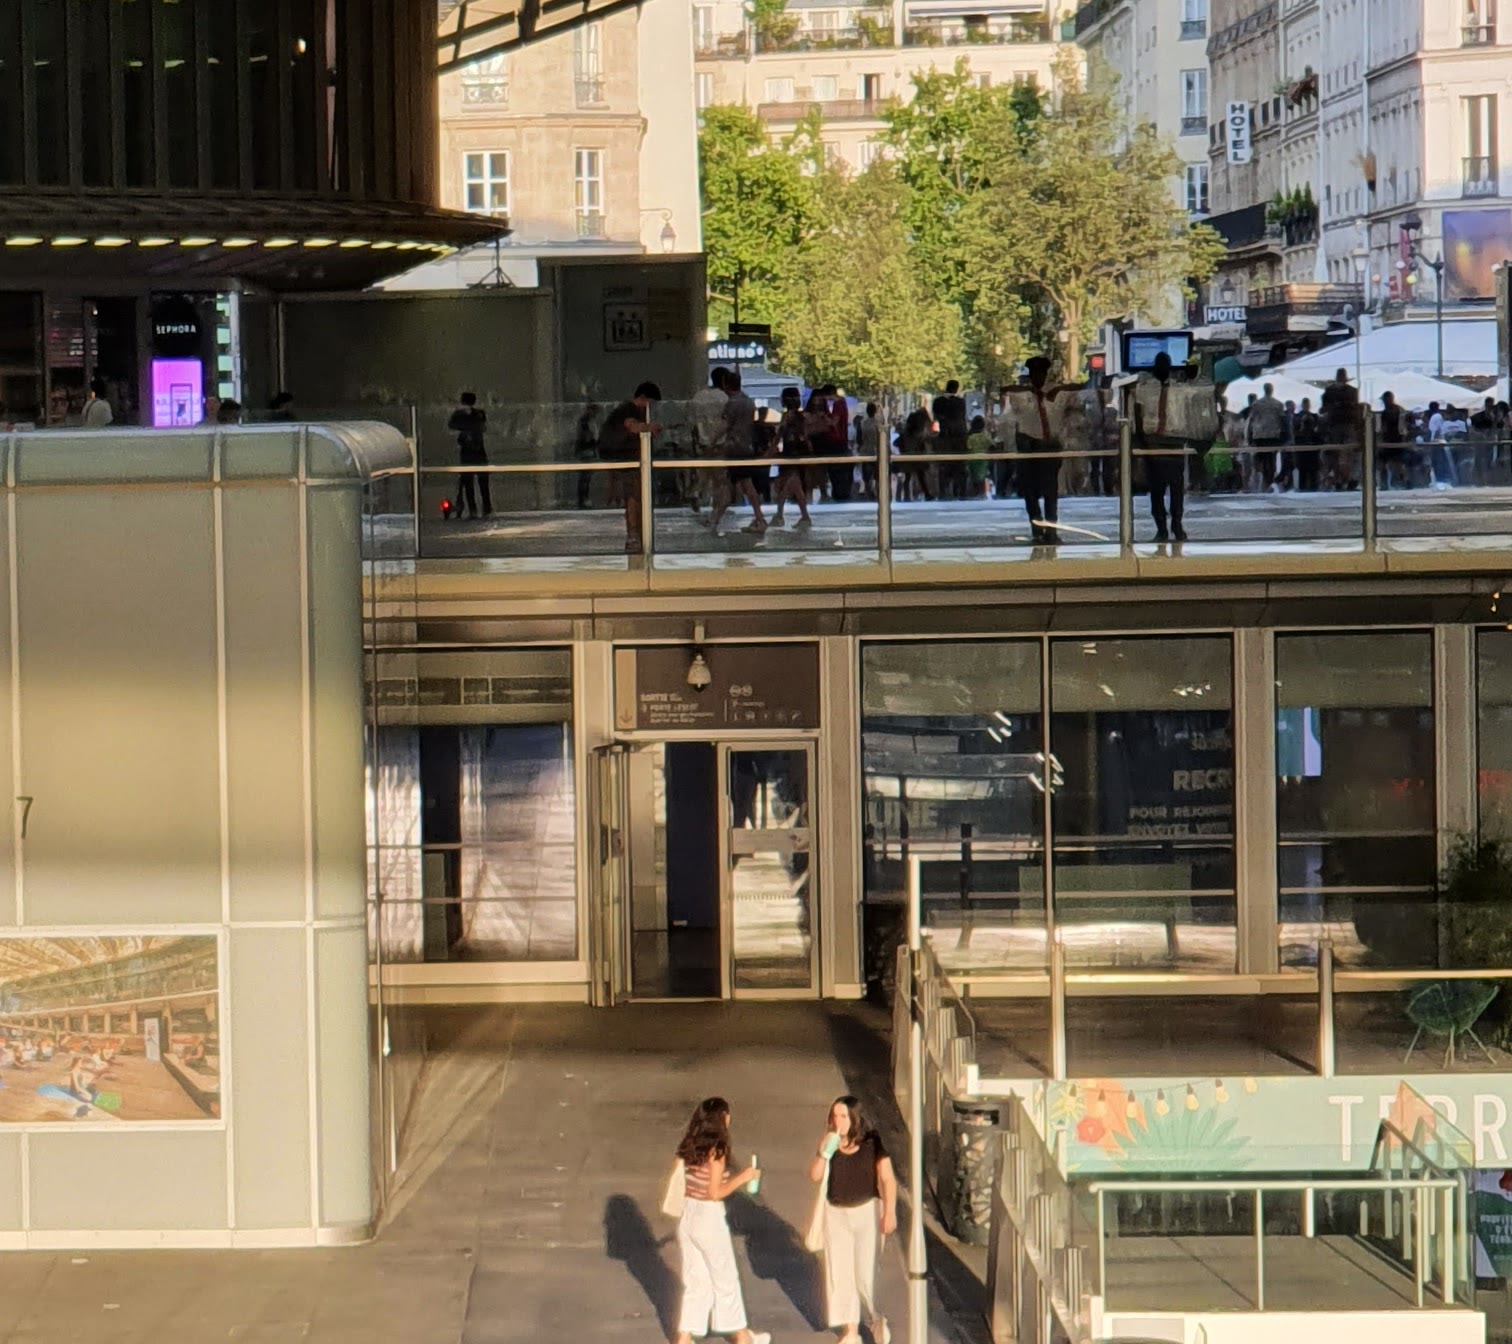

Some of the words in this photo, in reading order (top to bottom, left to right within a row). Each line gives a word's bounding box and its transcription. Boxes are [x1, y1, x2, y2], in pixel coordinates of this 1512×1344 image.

[1230, 103, 1246, 162] HOTEL
[155, 323, 197, 335] SEPHORA
[1207, 307, 1248, 322] HOTEL
[16, 796, 34, 840] 7
